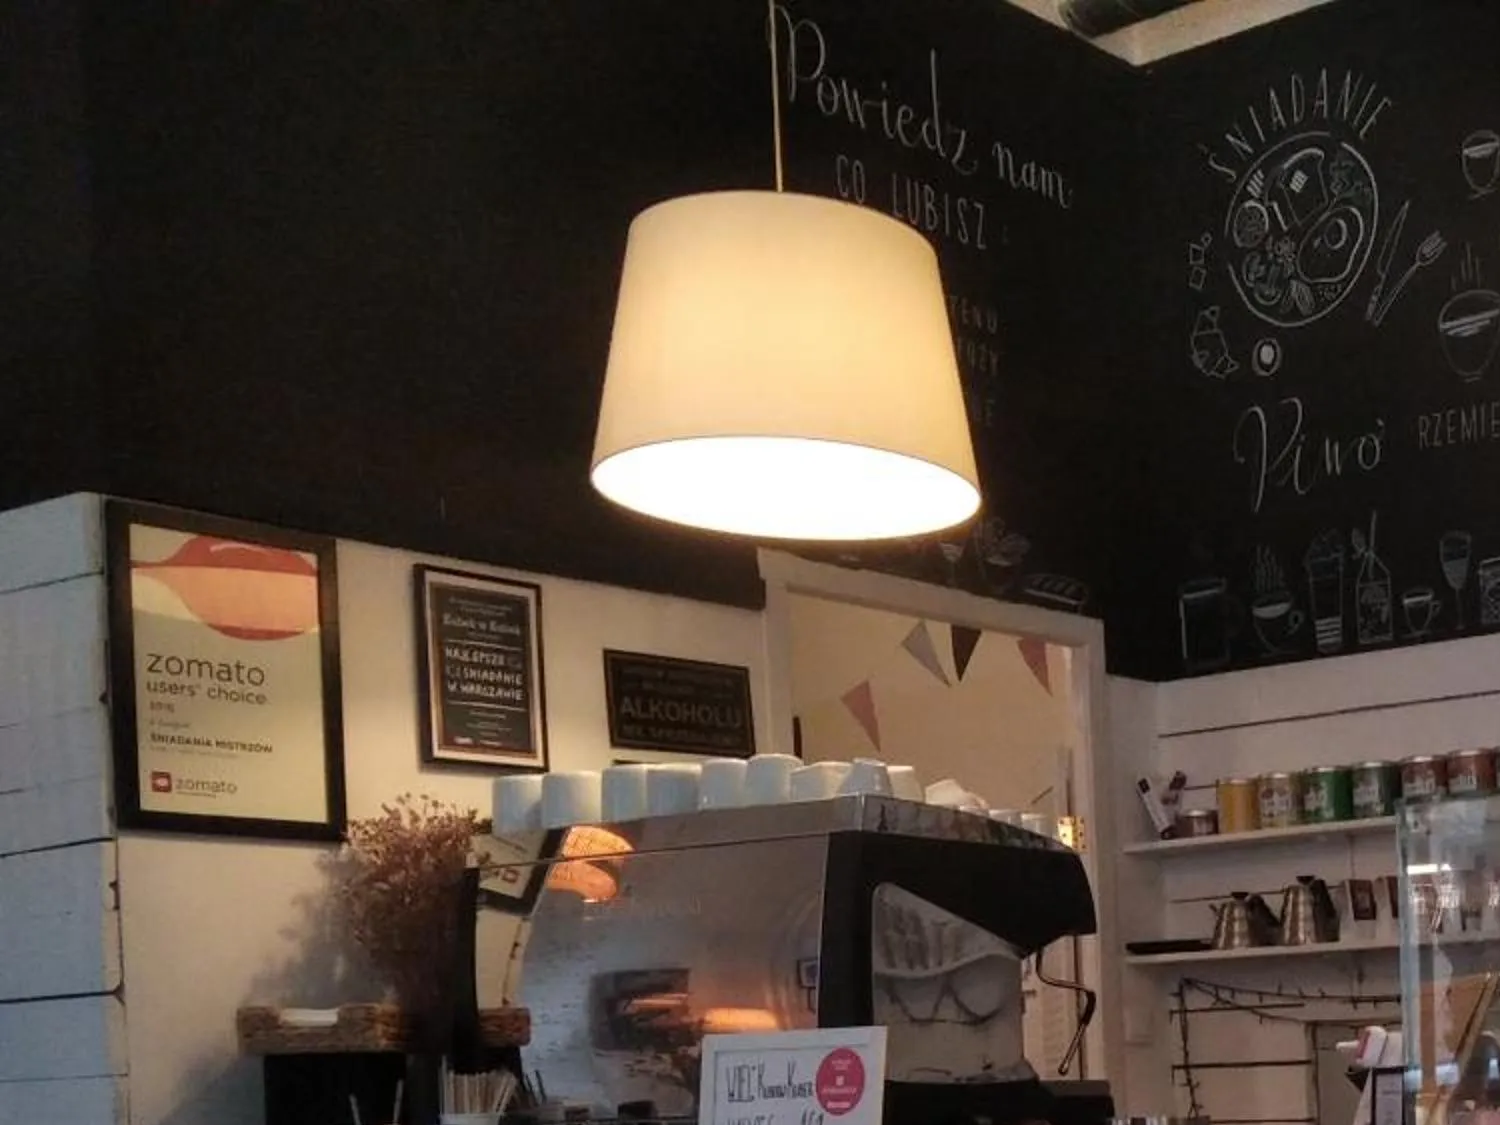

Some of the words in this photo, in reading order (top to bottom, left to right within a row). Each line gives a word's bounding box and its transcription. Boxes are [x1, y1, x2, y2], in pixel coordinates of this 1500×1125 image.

[146, 653, 265, 687] zomato
[206, 686, 268, 706] choice
[176, 778, 239, 795] zomato
